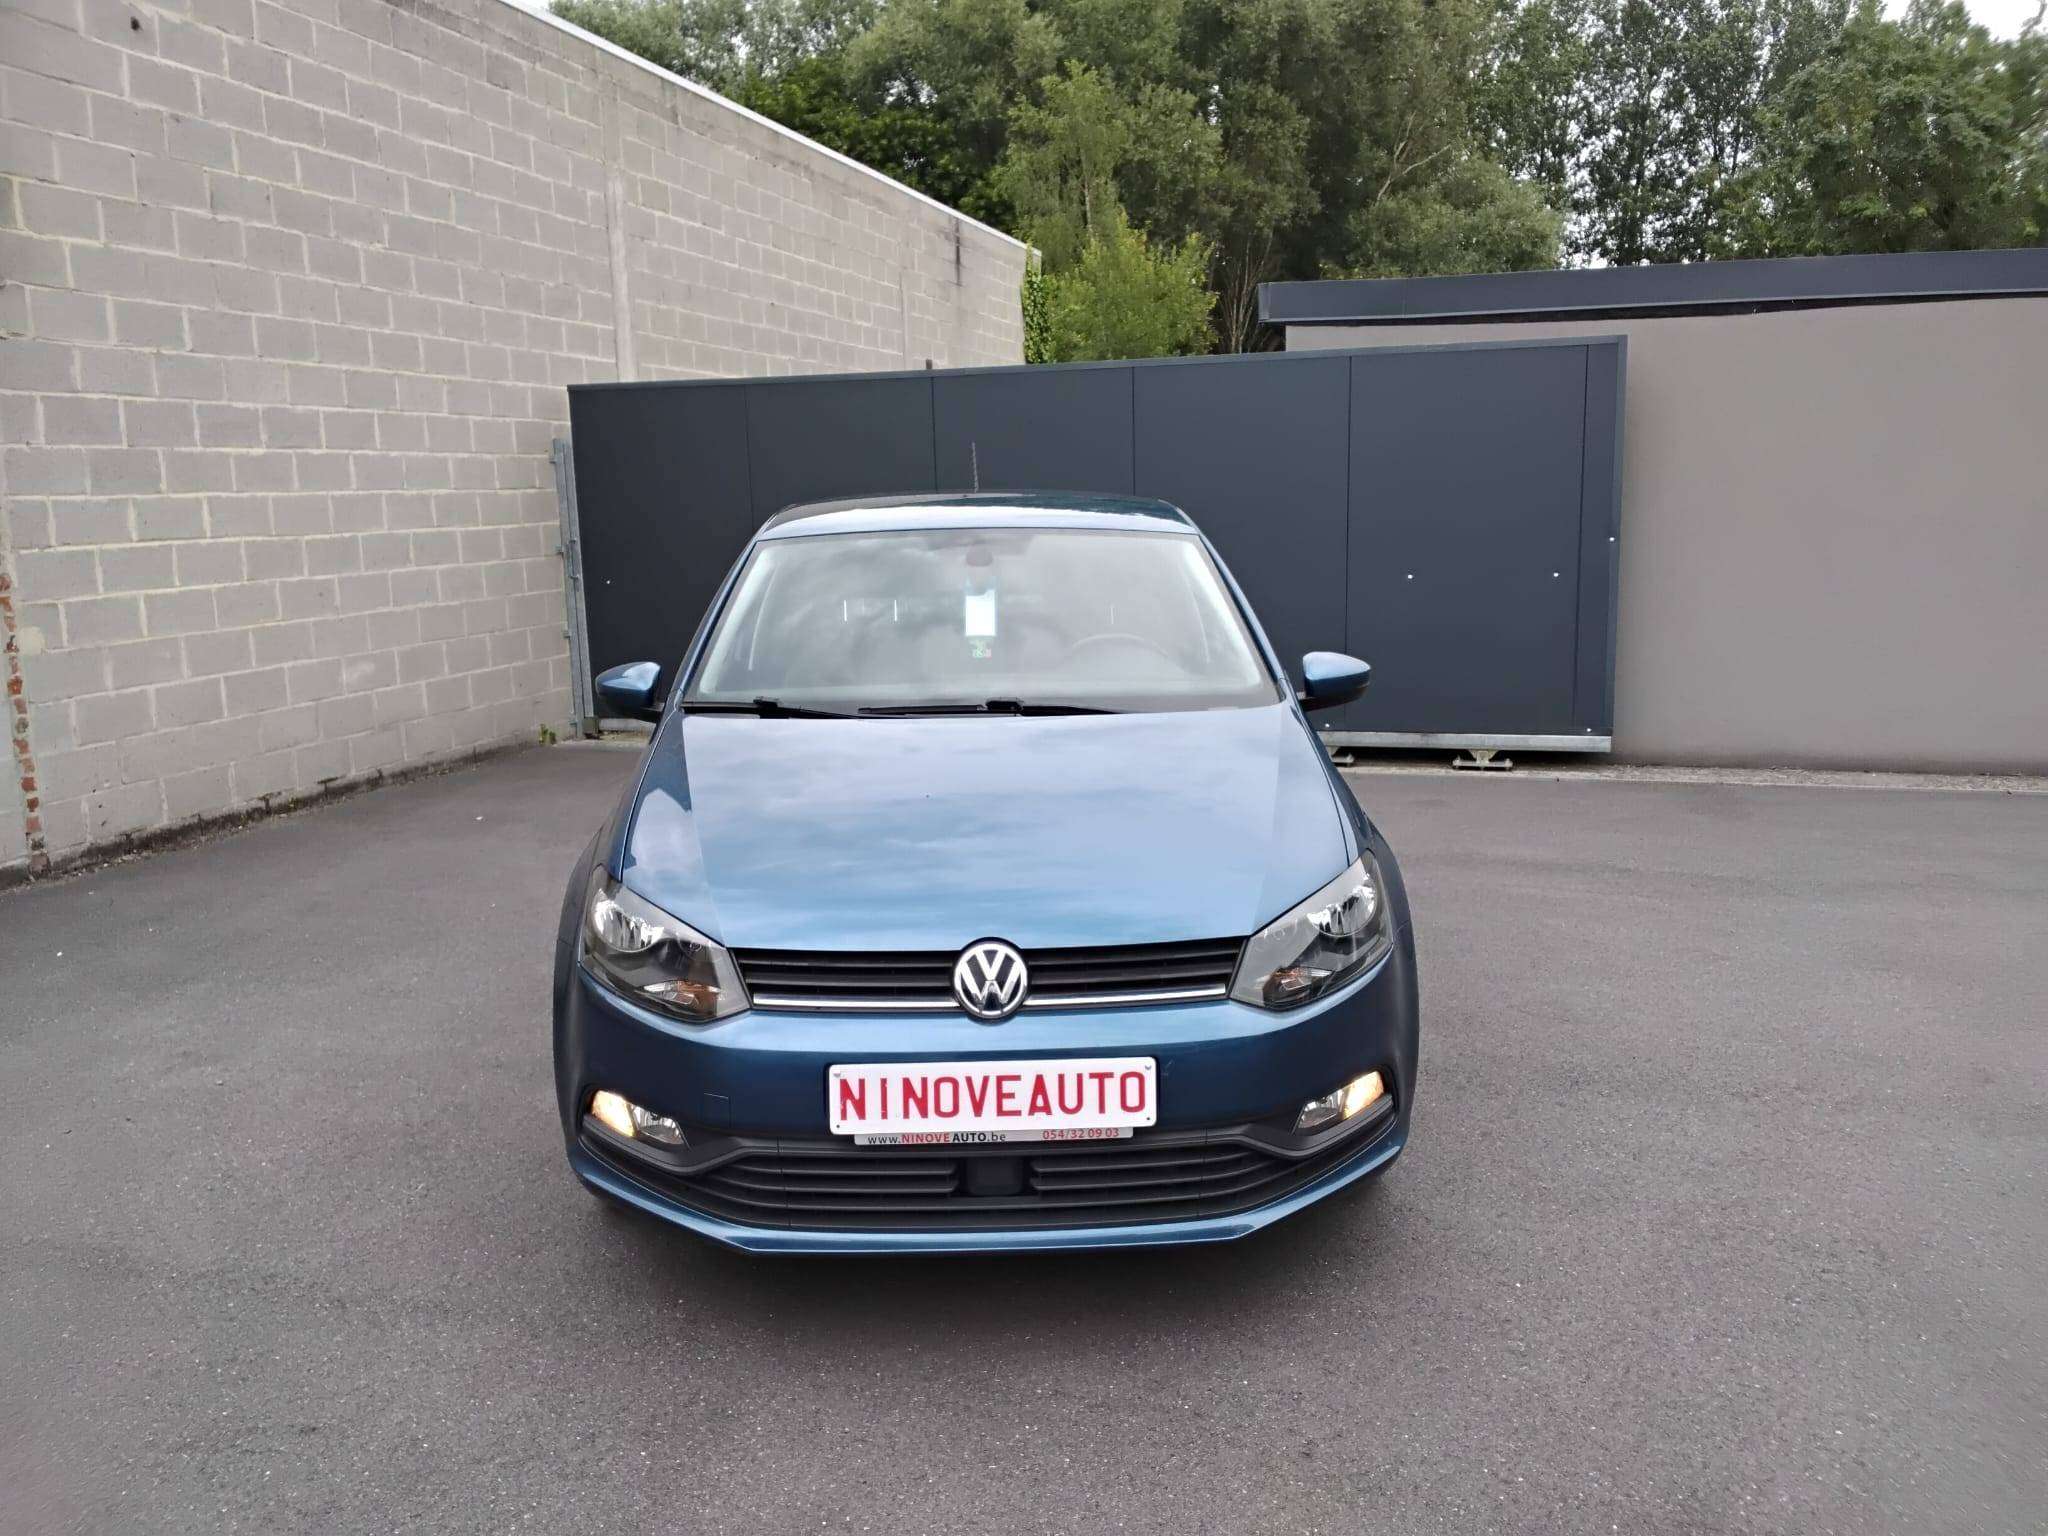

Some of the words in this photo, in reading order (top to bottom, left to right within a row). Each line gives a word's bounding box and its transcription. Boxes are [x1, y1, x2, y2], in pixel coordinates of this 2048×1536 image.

[956, 943, 1025, 1015] VW
[839, 1071, 1146, 1121] NINOVEAUTO
[867, 1131, 1006, 1145] www.NINOVEAUTO.be
[1042, 1128, 1085, 1140] 054/32
[1087, 1127, 1103, 1138] 09
[1105, 1127, 1120, 1138] 03
